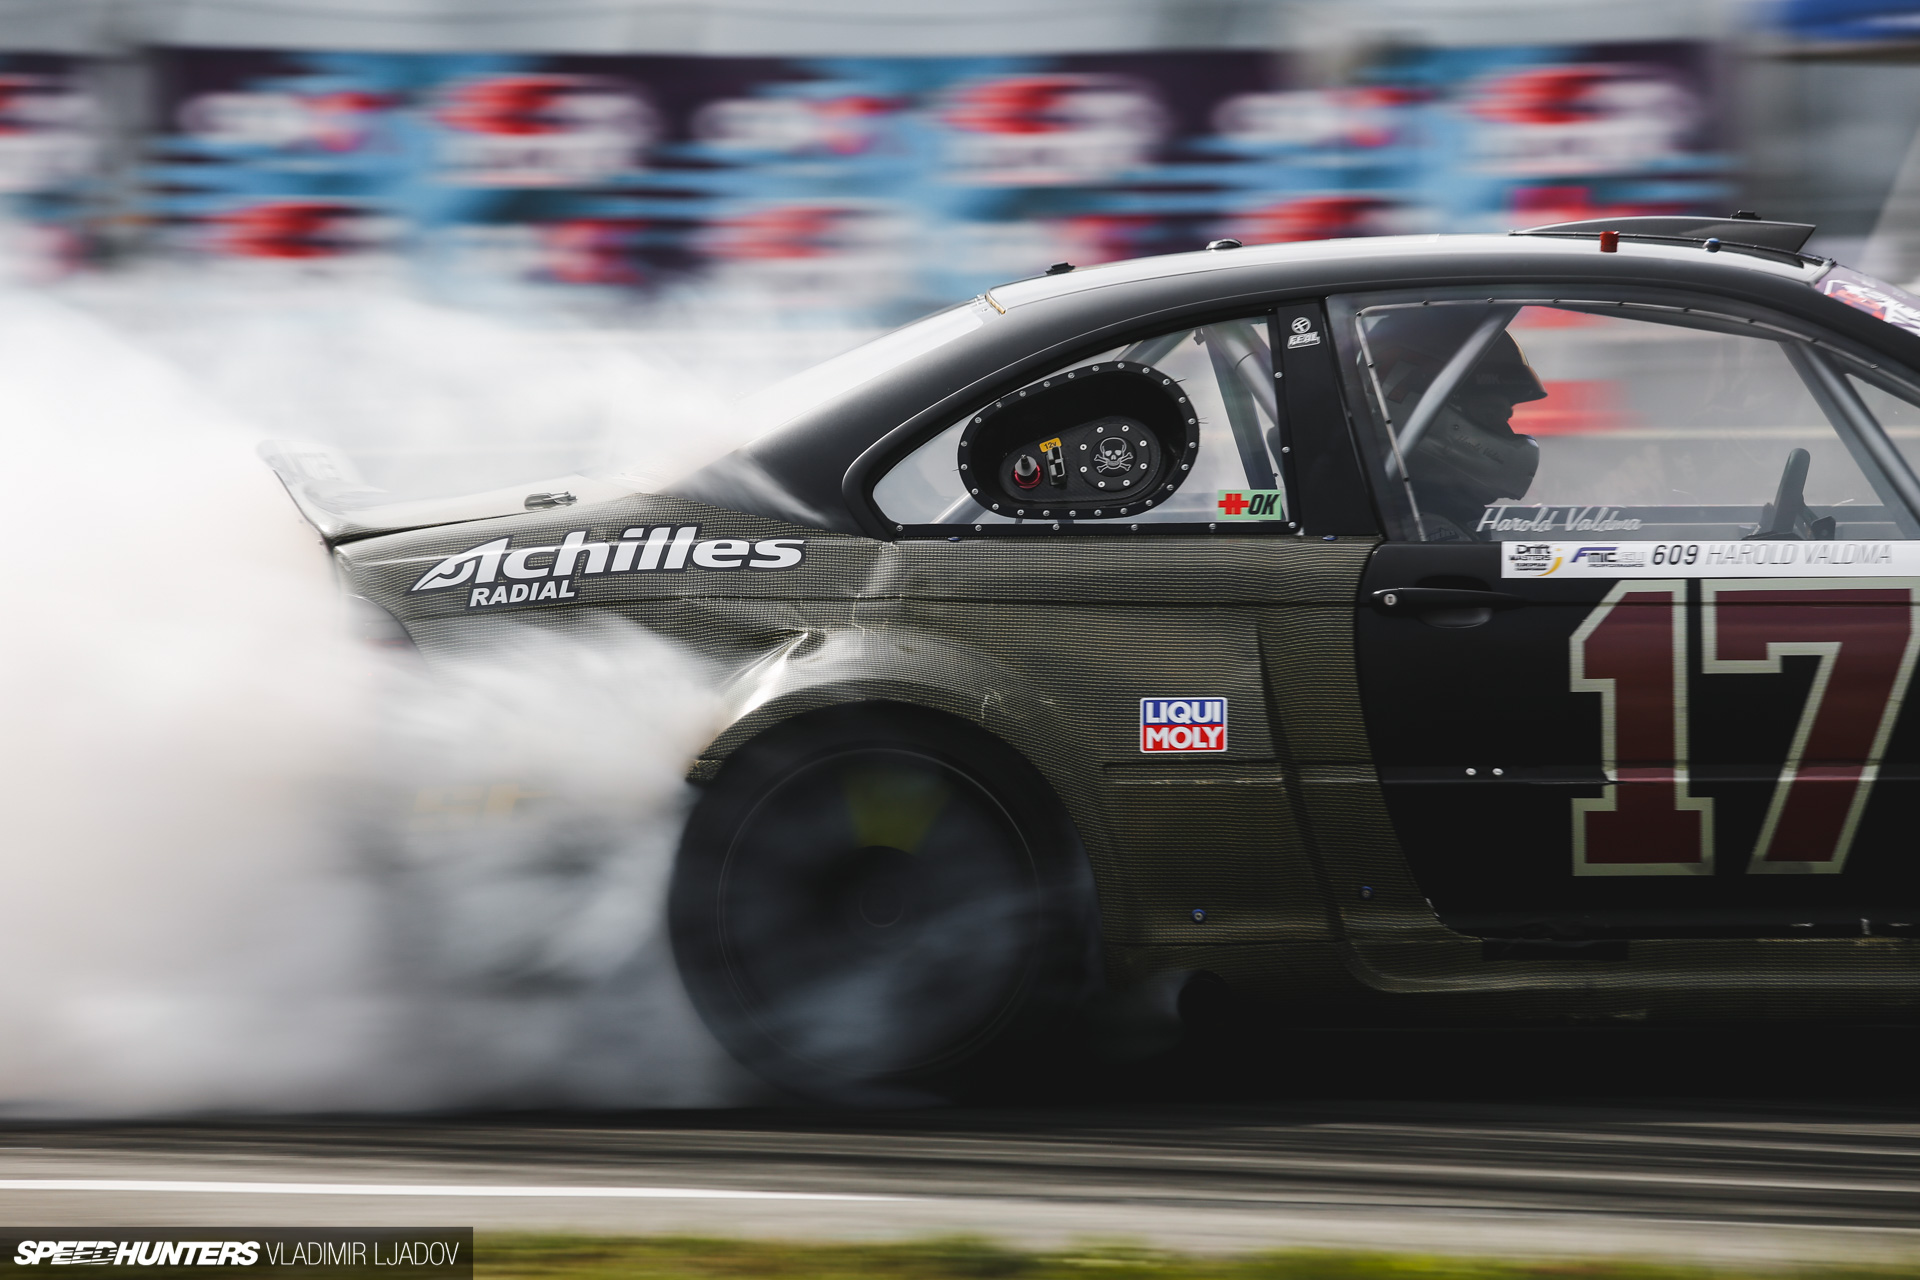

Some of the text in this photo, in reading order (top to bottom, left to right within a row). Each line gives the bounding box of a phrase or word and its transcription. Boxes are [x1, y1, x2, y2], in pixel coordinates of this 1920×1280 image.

[1248, 494, 1280, 515] OK
[1476, 506, 1558, 532] Harold
[411, 526, 806, 592] Achilles
[1652, 544, 1893, 565] 609 HAROLD VALDMA
[469, 579, 575, 608] RADIAL
[1145, 701, 1222, 724] LIQUI
[1145, 726, 1224, 749] MOLY
[1569, 577, 1920, 876] 17
